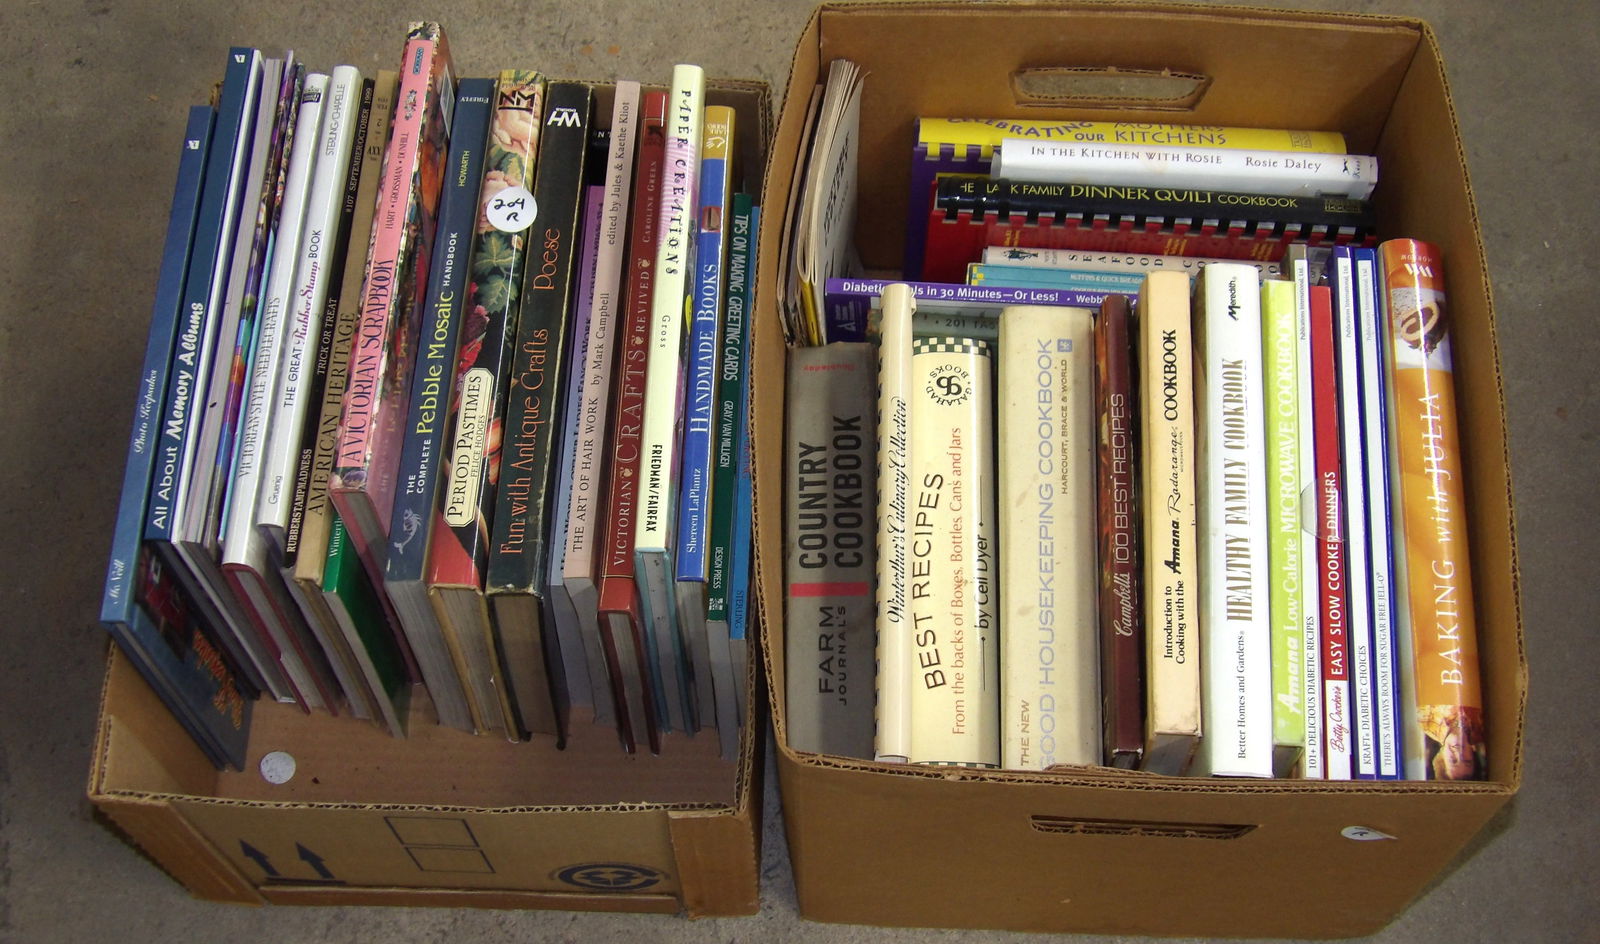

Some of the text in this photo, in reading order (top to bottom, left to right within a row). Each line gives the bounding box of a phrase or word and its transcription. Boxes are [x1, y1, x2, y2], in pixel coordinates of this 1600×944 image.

[618, 128, 627, 159] Kaethe
[620, 102, 630, 126] Kliot
[1074, 131, 1226, 145] OUR KITCHENS
[458, 150, 470, 188] HOWARTH
[614, 174, 623, 199] Jules
[666, 90, 692, 275] PAPER CREATIONS
[1031, 146, 1322, 173] IN THE KITCHEN WITH ROSIE Rosie Daley
[385, 207, 394, 230] HART
[493, 198, 525, 210] 204
[608, 216, 618, 245] edited
[611, 200, 620, 214] by
[734, 214, 749, 235] TIPS
[1022, 184, 1298, 208] FAMILY DINNER QUILT COOKBOOK
[730, 253, 746, 292] MAKING
[733, 236, 747, 251] ON
[1068, 254, 1163, 268] SEAFOOD
[284, 230, 322, 408] THE GREAT BOOK
[596, 292, 610, 340] Campbell
[725, 296, 743, 346] GREETING
[927, 286, 937, 296] in
[940, 288, 954, 298] 30
[1030, 290, 1060, 302] Less!
[318, 298, 337, 375] TRICK OR TREAT
[342, 260, 394, 464] A VICTORIAN SCRAPBOOK
[416, 232, 458, 434] Pebble Mosaic HANDBOOK
[592, 341, 604, 370] Mark
[614, 160, 657, 566] VICTORIAN CRAFTS REVIVED CAROLINE GREEN
[724, 347, 739, 382] CARDS
[500, 228, 560, 554] Fun with Antique Crafts Poese
[590, 370, 600, 386] by
[687, 264, 718, 553] Shereen LaPlantz HANDMADE BOOKS
[153, 302, 206, 530] All About Memory Albums
[307, 312, 356, 516] AMERICAN HERITAGE
[446, 376, 482, 518] PERIOD PASTIMES
[471, 414, 486, 478] FELICE HODGES
[586, 397, 599, 438] WORK
[645, 314, 671, 532] Gross FRIEDMAN/FAIRFAX
[406, 474, 416, 495] THE
[416, 438, 432, 495] COMPLETE
[582, 438, 594, 472] HAIR
[888, 396, 910, 534] Culinary Collection
[1111, 393, 1129, 564] 100 BEST RECIPES
[1163, 329, 1182, 574] Amana Radarange COOKBOOK
[288, 448, 312, 553] RUBBERSTAMPMADNESS
[576, 500, 588, 524] ART
[579, 476, 590, 498] OF
[798, 442, 828, 569] COUNTRY
[832, 415, 862, 569] COOKBOOK
[1222, 358, 1252, 622] HEALTHY FAMILY COOKBOOK
[1276, 312, 1300, 715] Amana MICROWAVE COOKBOOK
[573, 528, 584, 553] THE
[715, 546, 724, 568] DESIGN
[1038, 338, 1056, 770] GOOD HOUSEKEEPING COOKBOOK
[1418, 392, 1463, 686] BAKING with JULIA
[712, 570, 722, 589] PRESS
[734, 590, 745, 628] STERLING
[912, 472, 948, 690] BEST RECIPES
[949, 427, 965, 735] From the backs of Boxes, Cans and Jars
[974, 537, 990, 629] by Dyer
[1324, 471, 1349, 752] Betty EASY SLOW COOKER DINNERS
[819, 605, 834, 694] FARM
[1164, 585, 1173, 658] Introduction to
[1175, 580, 1186, 664] Cooking with the
[1236, 676, 1246, 759] Better Homes and
[1306, 616, 1316, 769] 101+ DELICIOUS DIABETIC RECIPES
[1358, 644, 1370, 730] DIABETIC CHOICES
[1377, 600, 1392, 767] THERE'S ALWAYS ROOM FOR SUGAR FREE
[1020, 700, 1031, 767] THE NEW
